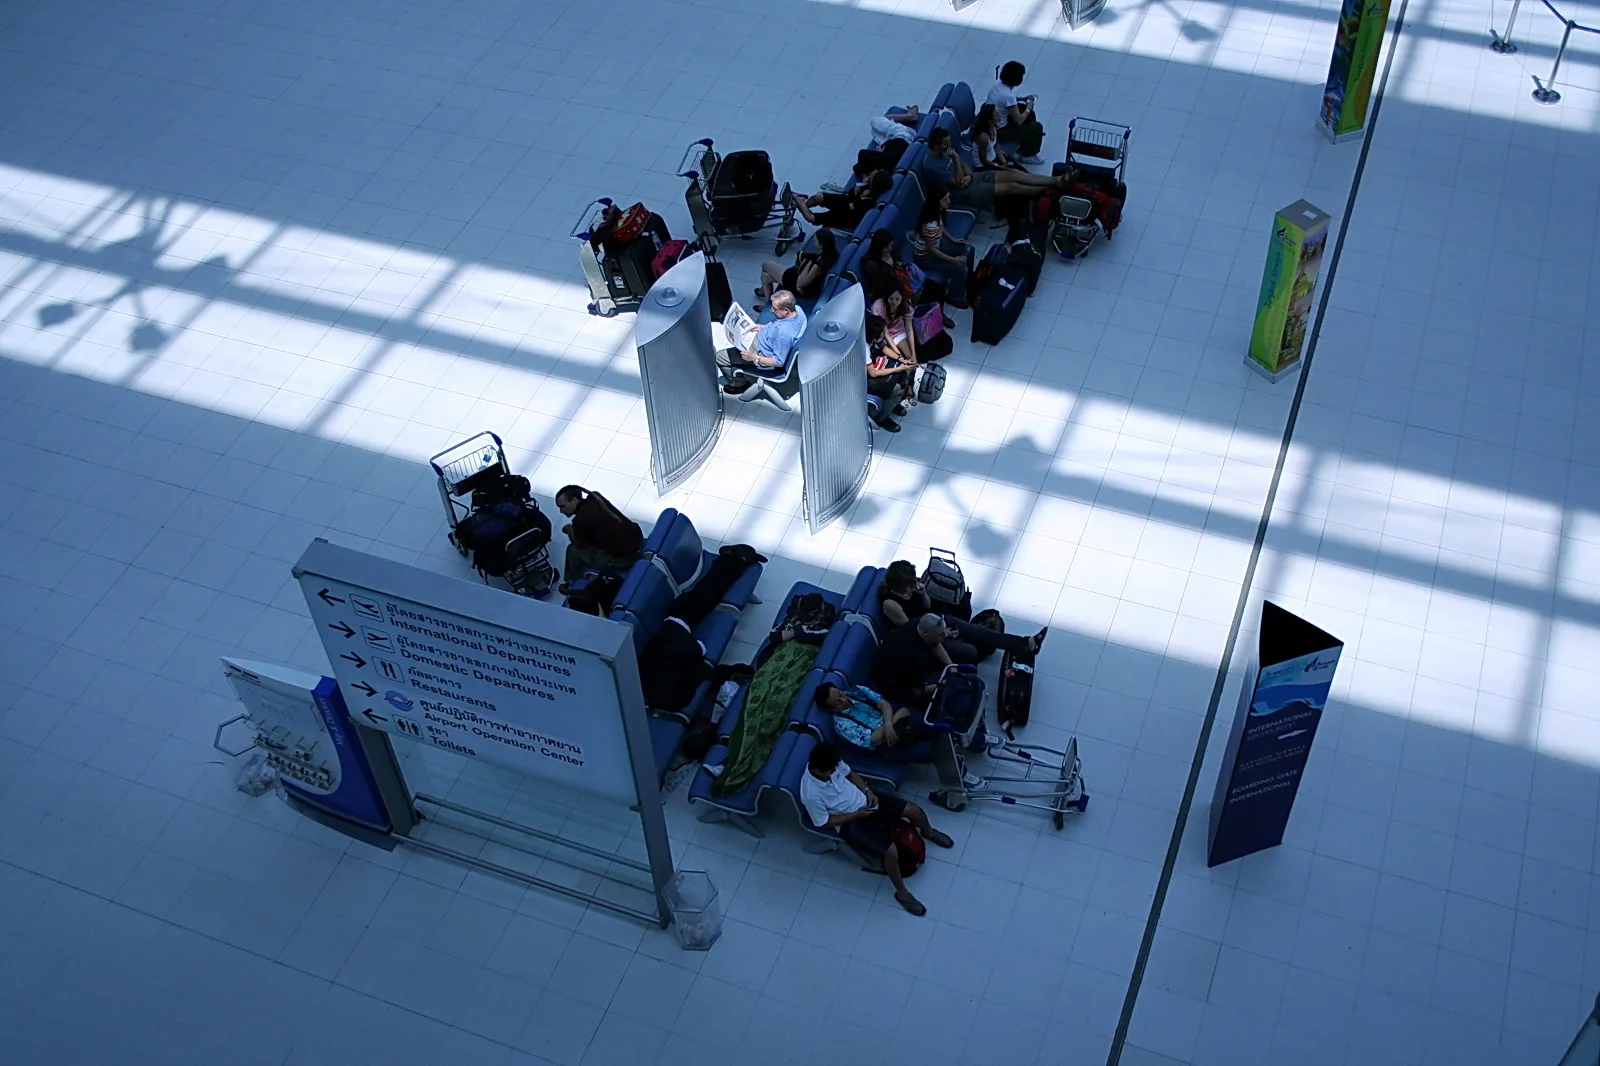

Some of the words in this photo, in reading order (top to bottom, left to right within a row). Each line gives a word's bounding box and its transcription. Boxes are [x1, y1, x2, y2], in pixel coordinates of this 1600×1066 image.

[390, 617, 483, 651] International
[487, 645, 572, 677] Departures
[400, 648, 469, 676] Domestic
[473, 669, 556, 701] Departures
[408, 666, 462, 689] ภัตตาคาร
[410, 678, 497, 711] Restaurants
[424, 713, 468, 732] Airport
[472, 727, 536, 753] Operation
[541, 747, 584, 767] Center
[426, 725, 449, 738] สุขา
[430, 735, 476, 756] Toilets
